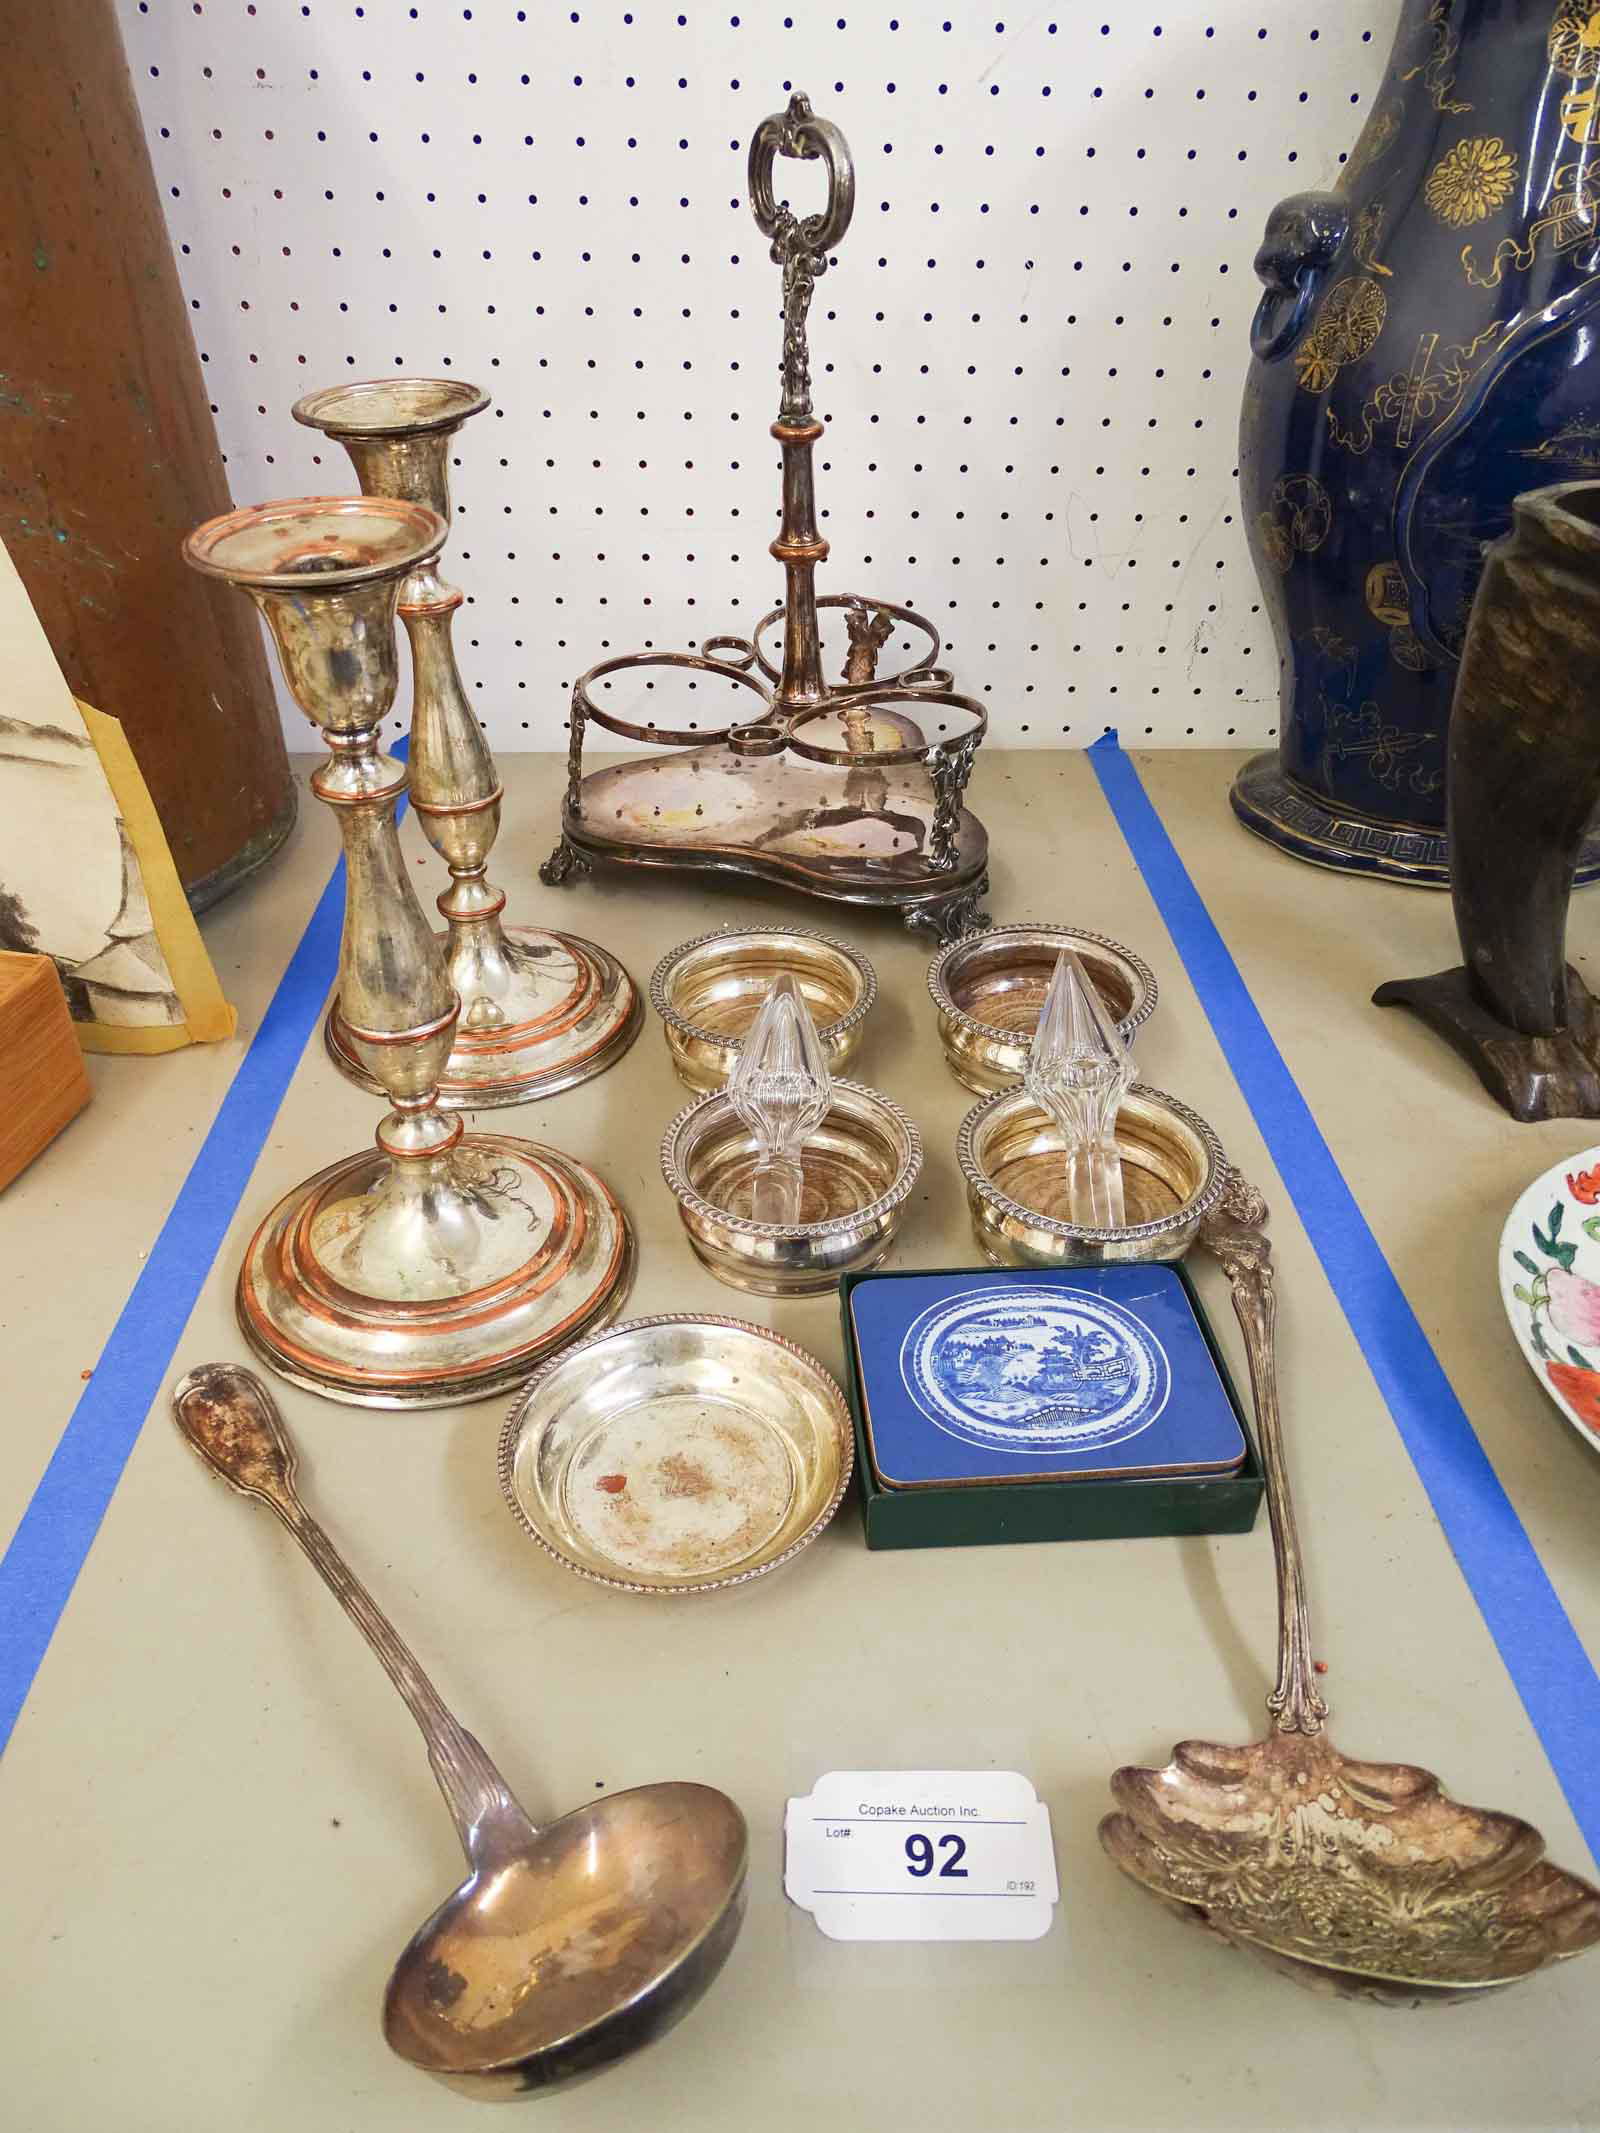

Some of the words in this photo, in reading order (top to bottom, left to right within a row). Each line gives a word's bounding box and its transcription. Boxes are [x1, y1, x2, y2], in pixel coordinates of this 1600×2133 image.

[858, 1803, 906, 1817] Copake
[910, 1804, 956, 1817] Auction
[904, 1833, 969, 1878] 92
